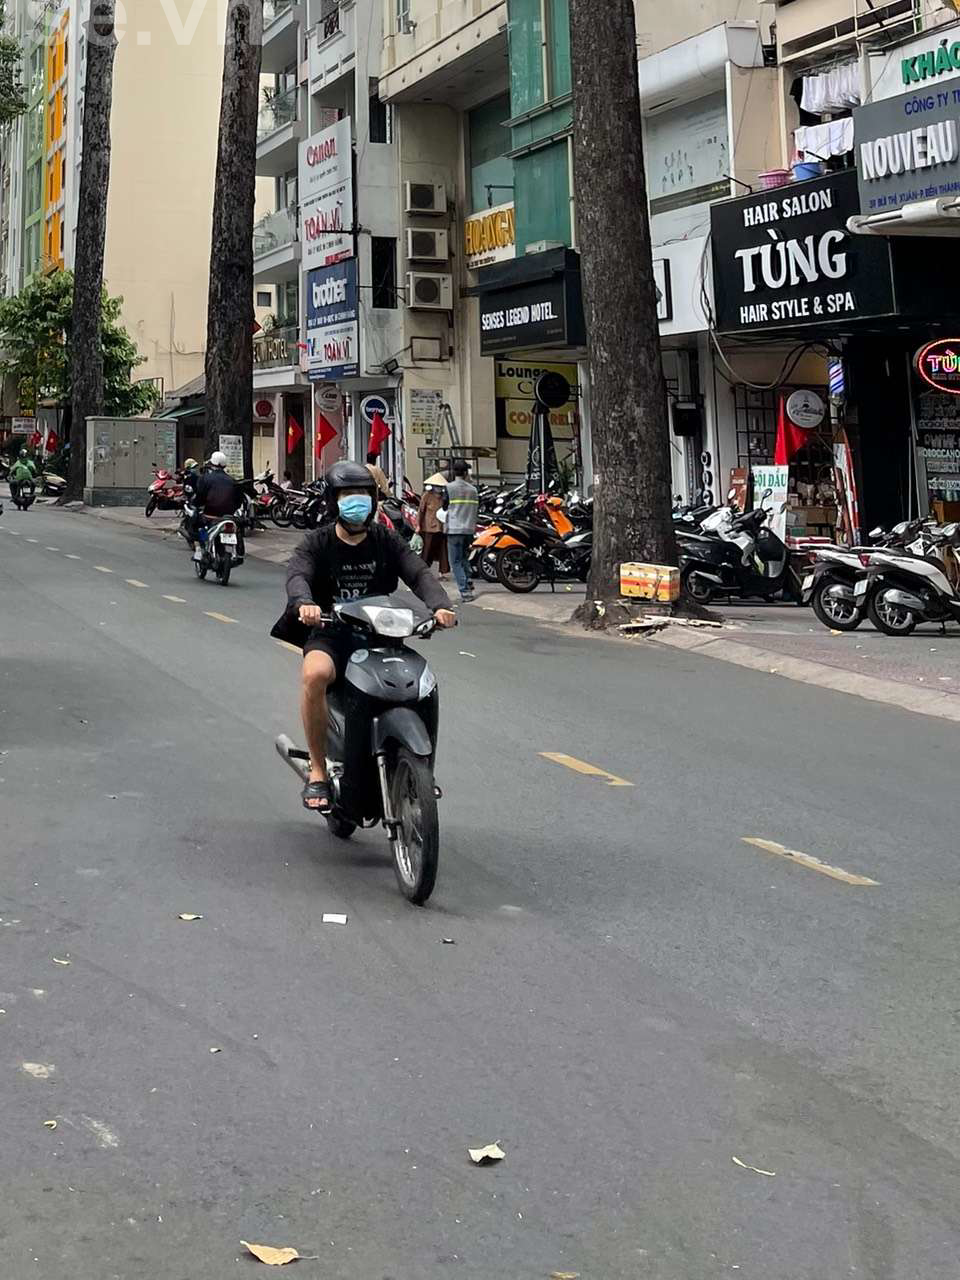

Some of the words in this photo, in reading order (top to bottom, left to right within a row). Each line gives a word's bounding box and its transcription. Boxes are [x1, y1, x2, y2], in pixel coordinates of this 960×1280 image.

[905, 95, 935, 116] CÔNG
[937, 91, 949, 108] TY
[306, 137, 337, 167] Canon
[860, 120, 958, 181] NOUVEAU
[743, 201, 779, 227] HAIR
[782, 188, 833, 218] SALON
[734, 228, 847, 293] TÙNG
[312, 277, 348, 308] brother
[740, 304, 769, 324] HAIR
[771, 297, 810, 320] STYLE
[813, 296, 824, 315] &
[827, 292, 855, 313] SPA
[482, 310, 505, 331] SENSES
[506, 305, 530, 327] LEGEND
[531, 301, 555, 323] HOTEL
[498, 363, 548, 381] Loung
